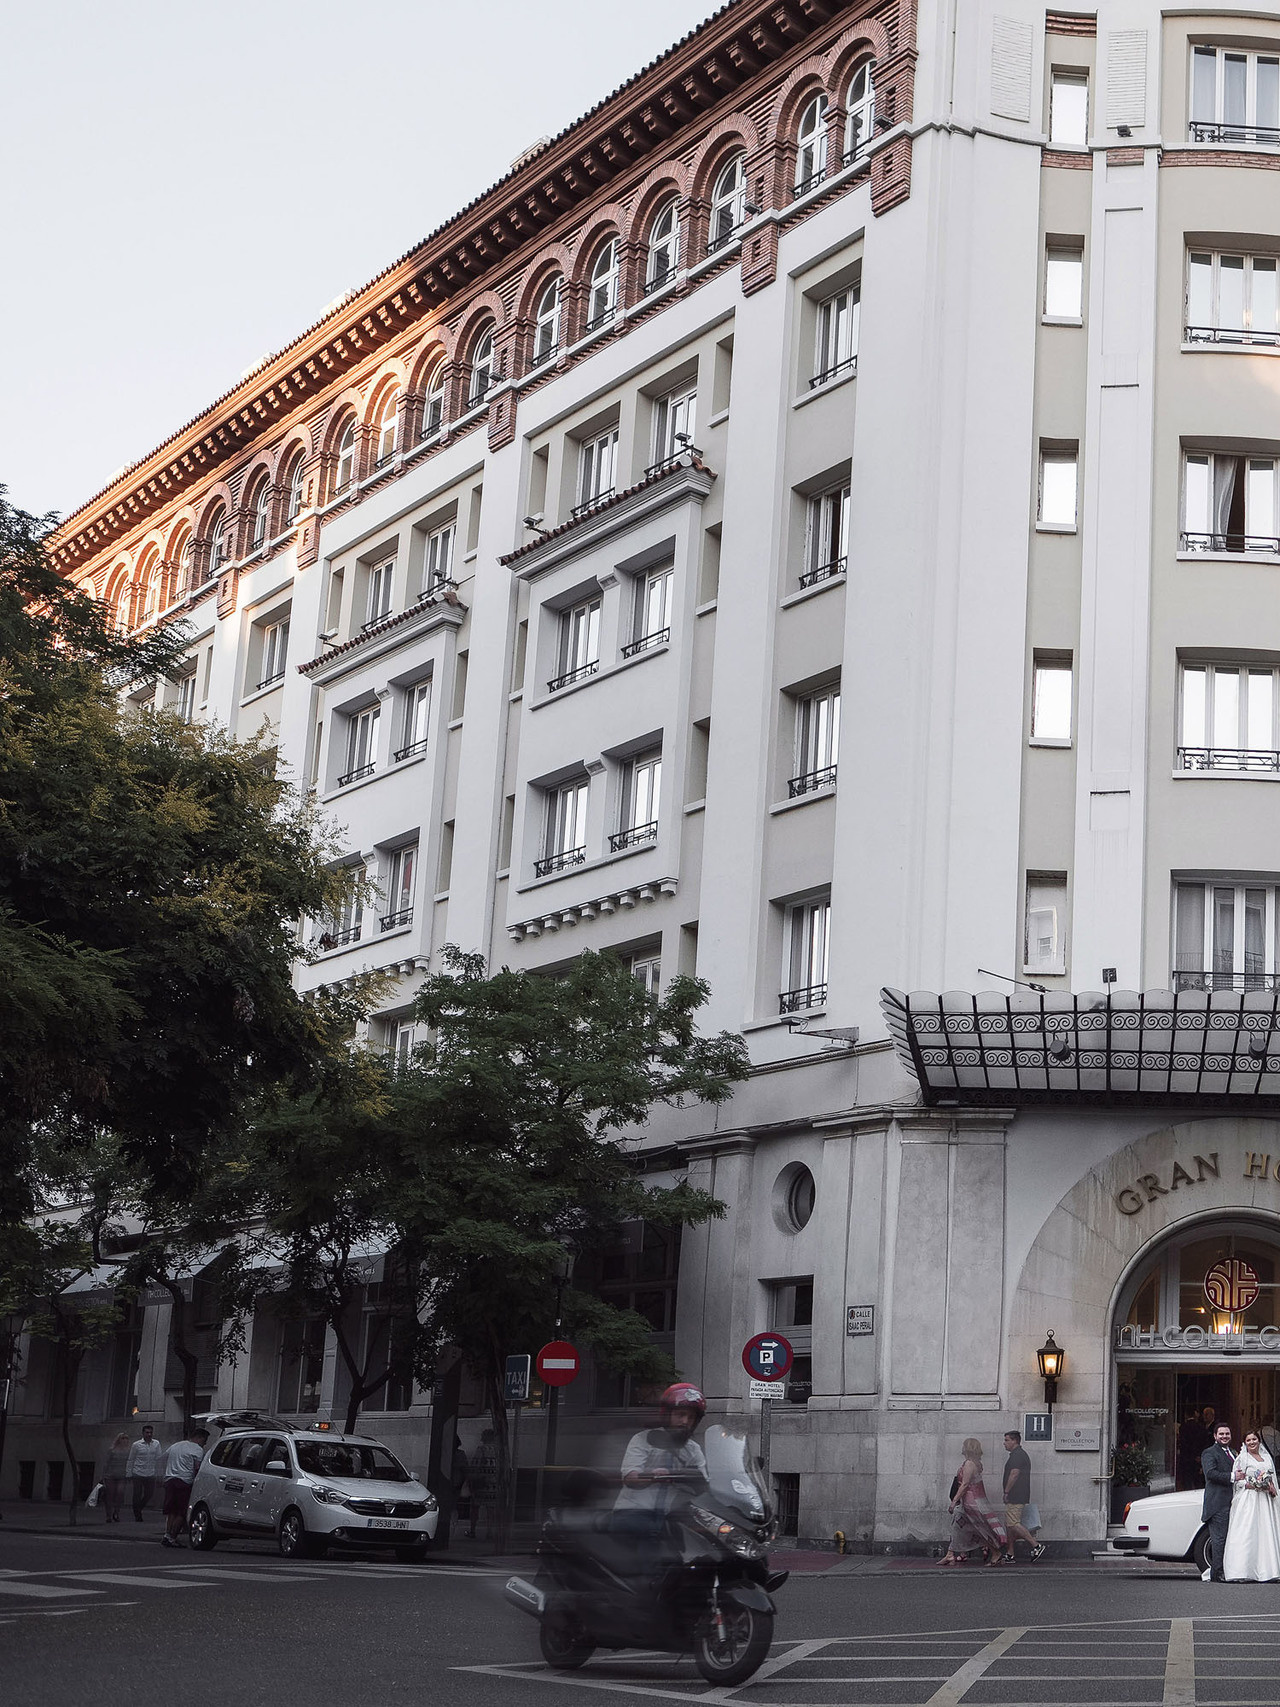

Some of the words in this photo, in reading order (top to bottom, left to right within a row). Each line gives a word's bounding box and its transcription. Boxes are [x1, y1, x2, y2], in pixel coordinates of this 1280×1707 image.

[1115, 1152, 1221, 1216] GRAN
[848, 1322, 859, 1331] SAAC
[763, 1352, 771, 1362] P
[507, 1372, 527, 1385] TAXI
[1033, 1417, 1046, 1431] H
[375, 1519, 392, 1528] 3538
